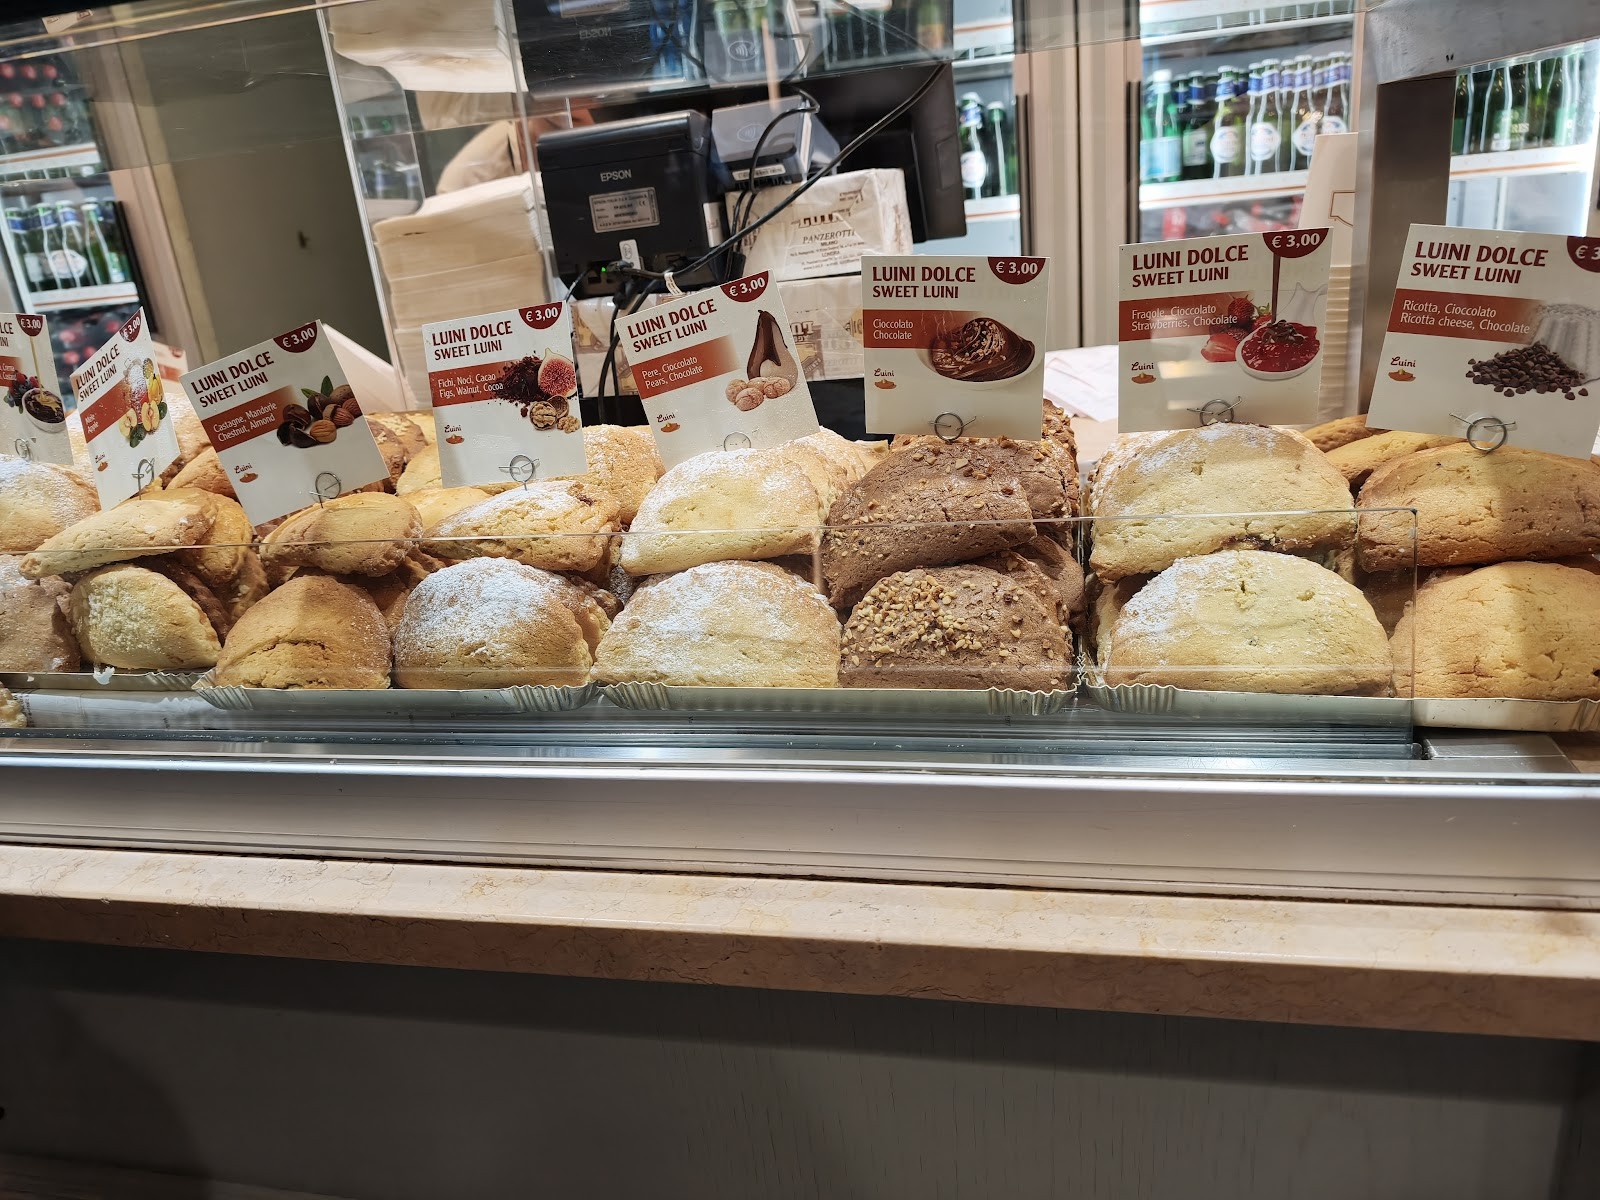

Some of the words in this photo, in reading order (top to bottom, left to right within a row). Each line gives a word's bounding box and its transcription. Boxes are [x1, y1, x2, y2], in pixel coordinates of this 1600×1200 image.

[600, 169, 632, 182] EPSON
[802, 229, 855, 244] PANZEROTTI
[1271, 236, 1282, 248] €
[1286, 233, 1320, 248] 3,00
[1132, 250, 1181, 271] LUINI
[1187, 245, 1249, 266] DOLCE
[1415, 241, 1471, 262] LUINI
[1476, 245, 1549, 267] DOLCE
[1575, 245, 1588, 259] €
[872, 266, 916, 282] LUINI
[921, 267, 976, 282] DOLCE
[996, 262, 1005, 274] €
[1008, 262, 1038, 276] 3,00
[1132, 270, 1185, 288] SWEET
[1189, 266, 1229, 283] LUINI
[1411, 262, 1470, 280] SWEET
[1474, 267, 1522, 284] LUINI
[729, 285, 738, 297] €
[740, 277, 766, 294] 3,00
[872, 286, 919, 298] SWEET
[923, 286, 959, 299] LUINI
[526, 310, 533, 322] €
[535, 306, 558, 321] 3,00
[1132, 307, 1167, 321] Fragole,
[1170, 304, 1217, 317] Cioccolato
[1403, 299, 1441, 314] Ricotta,
[1444, 303, 1497, 318] Cioccolato
[26, 318, 41, 329] 3,00
[127, 316, 140, 335] 3,00
[627, 314, 666, 339] LUINI
[668, 298, 717, 326] DOLCE
[873, 318, 914, 329] Cioccolato
[1132, 317, 1190, 332] Strawberries,
[1193, 315, 1238, 327] Chocolate
[1400, 313, 1435, 326] Ricotta
[1438, 317, 1475, 330] cheese,
[1479, 319, 1530, 334] Chocolate
[282, 338, 292, 348] €
[291, 327, 315, 345] 3,00
[432, 328, 466, 346] LUINI
[470, 320, 513, 340] DOLCE
[633, 330, 672, 353] SWEET
[676, 319, 708, 340] LUINI
[873, 329, 912, 340] Chocolate
[434, 344, 470, 361] SWEET
[474, 339, 502, 355] LUINI
[76, 366, 96, 390] LUINI
[96, 343, 120, 373] DOLCE
[642, 367, 661, 379] Pere,
[662, 356, 698, 373] Cioccolato
[1131, 361, 1154, 371] Luini
[1390, 357, 1416, 368] Luini
[191, 370, 229, 395] LUINI
[228, 351, 275, 379] DOLCE
[438, 375, 456, 389] Fichi,
[457, 375, 474, 386] Noci,
[475, 373, 496, 383] Cacao
[645, 376, 668, 389] Pears,
[669, 364, 704, 382] Chocolate
[874, 368, 895, 377] Luini
[79, 378, 100, 402] SWEET
[100, 364, 117, 384] LUINI
[200, 384, 237, 408] SWEET
[238, 371, 269, 392] LUINI
[439, 388, 456, 399] Figs,
[455, 384, 482, 396] Walnut,
[483, 382, 504, 392] Cocoa
[213, 414, 247, 433] Castagne,
[245, 402, 278, 419] Mandorle
[657, 412, 675, 423] Luini
[218, 423, 250, 442] Chestnut,
[250, 414, 275, 430] Almond
[444, 424, 462, 433] Luini
[234, 462, 252, 474] Luini
